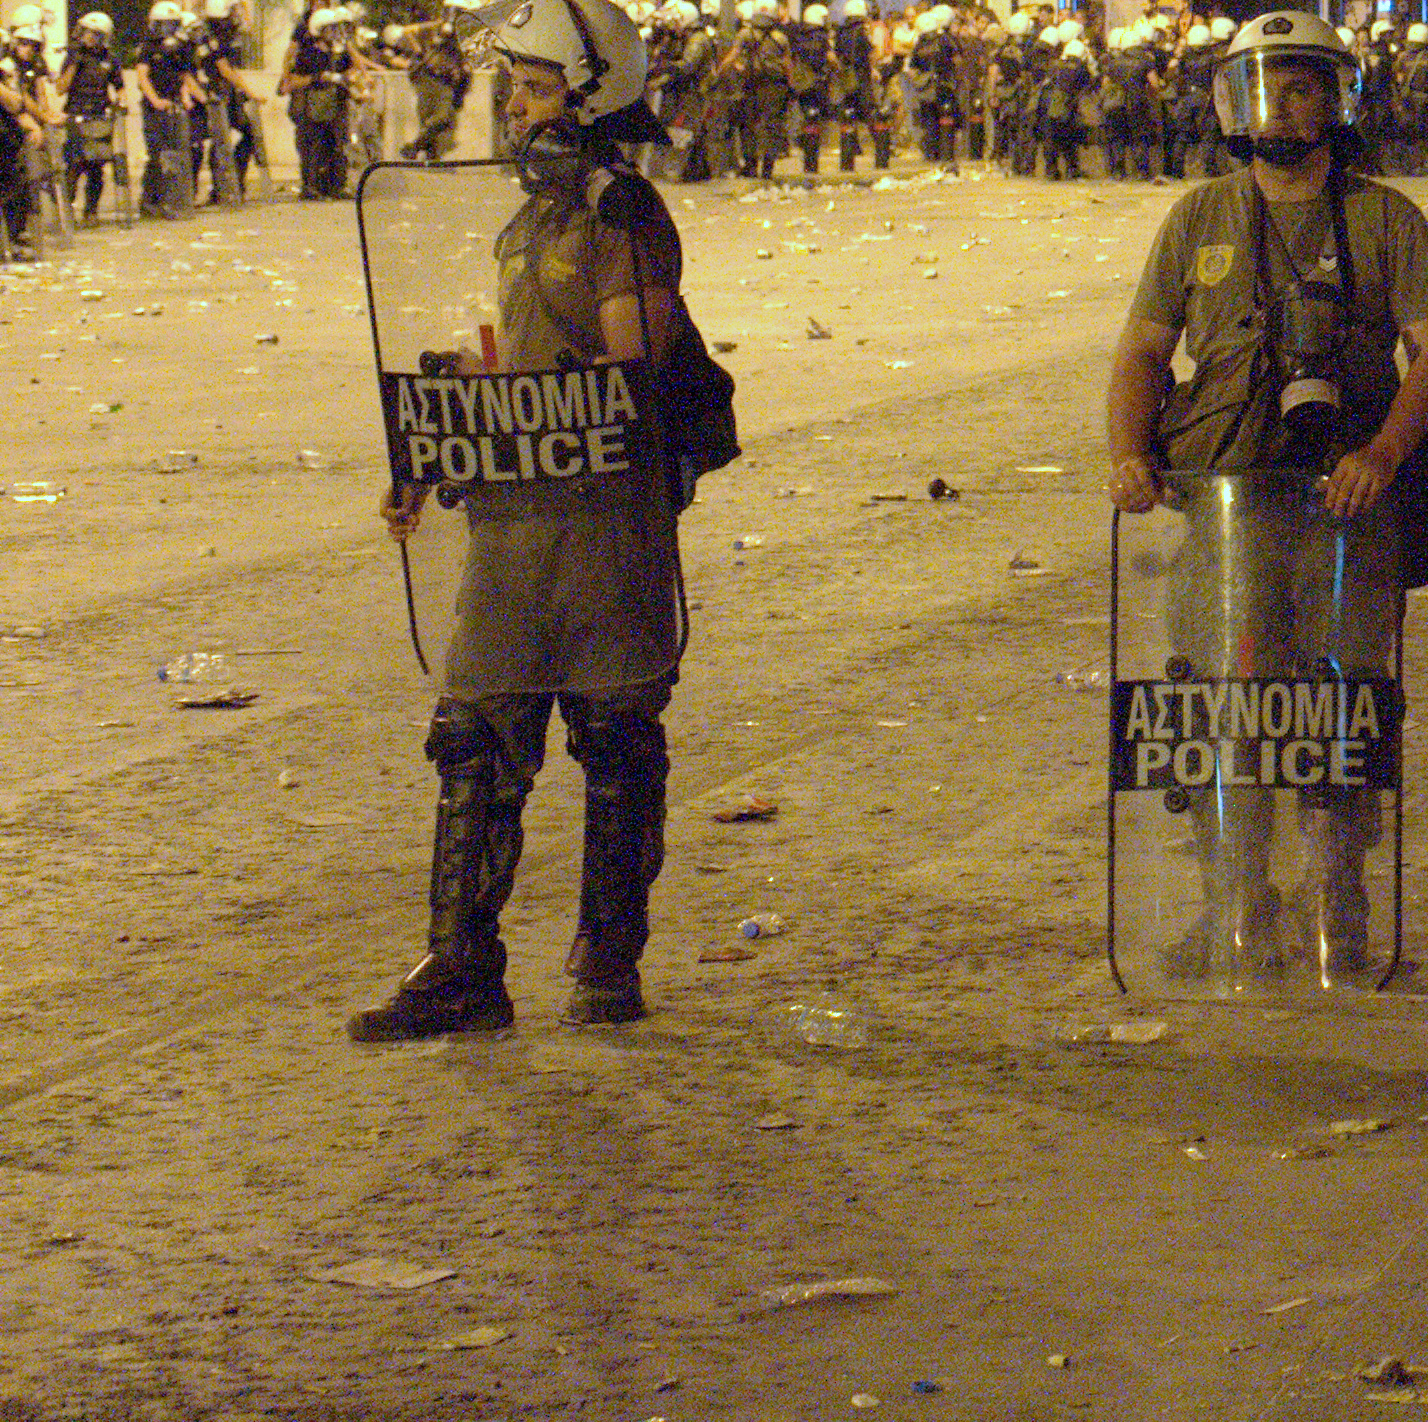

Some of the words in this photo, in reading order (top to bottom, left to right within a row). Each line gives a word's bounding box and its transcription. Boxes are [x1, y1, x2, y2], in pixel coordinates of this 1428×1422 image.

[397, 366, 638, 435] ΑΣΤΥΝΟΜΙΑ
[408, 424, 630, 481] POLICE
[1125, 682, 1380, 741] ΑΣΤΥΝΟΜΙΑ
[1135, 738, 1368, 787] POLICE
